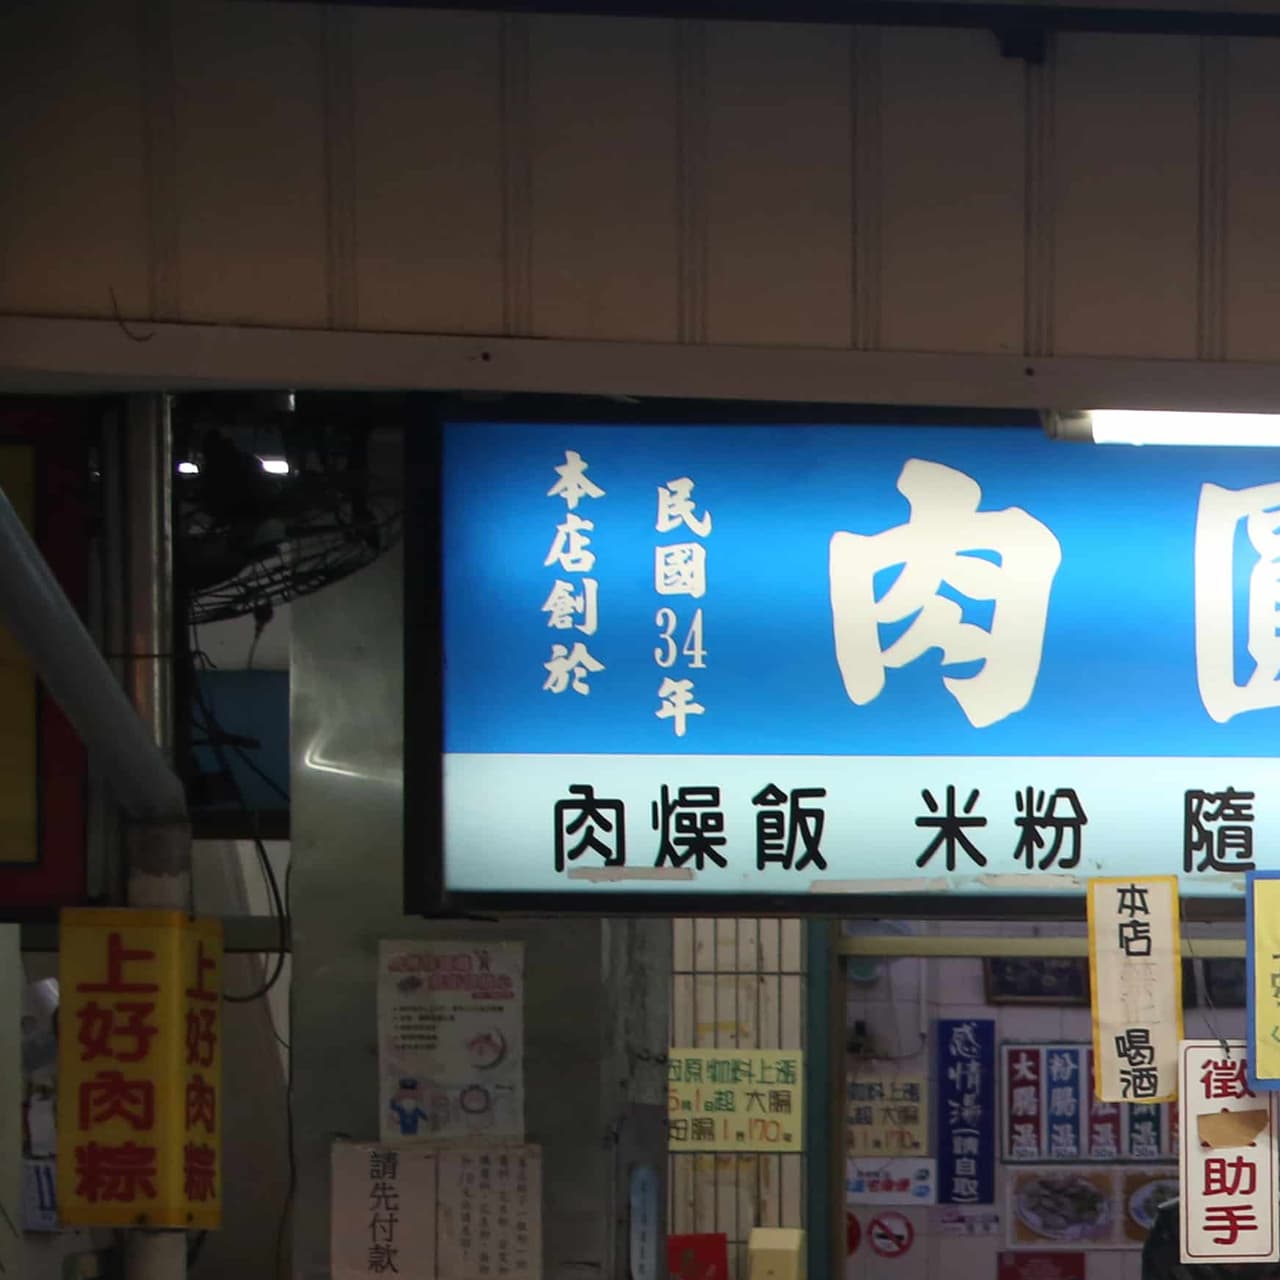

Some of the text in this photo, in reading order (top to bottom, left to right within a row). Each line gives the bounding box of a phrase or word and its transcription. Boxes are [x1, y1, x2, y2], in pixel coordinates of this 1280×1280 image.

[541, 451, 605, 695] 本店創於
[654, 478, 711, 736] 民國34年
[555, 784, 828, 871] 肉燥飯
[915, 785, 1087, 871] 米粉
[1116, 884, 1152, 956] 本店
[76, 932, 159, 1203] 上好肉粽
[183, 941, 218, 1202] 上好肉粽
[1115, 1029, 1158, 1098] 喝酒
[1200, 1059, 1258, 1247] 徵助手
[368, 1151, 399, 1274] 請先付款
